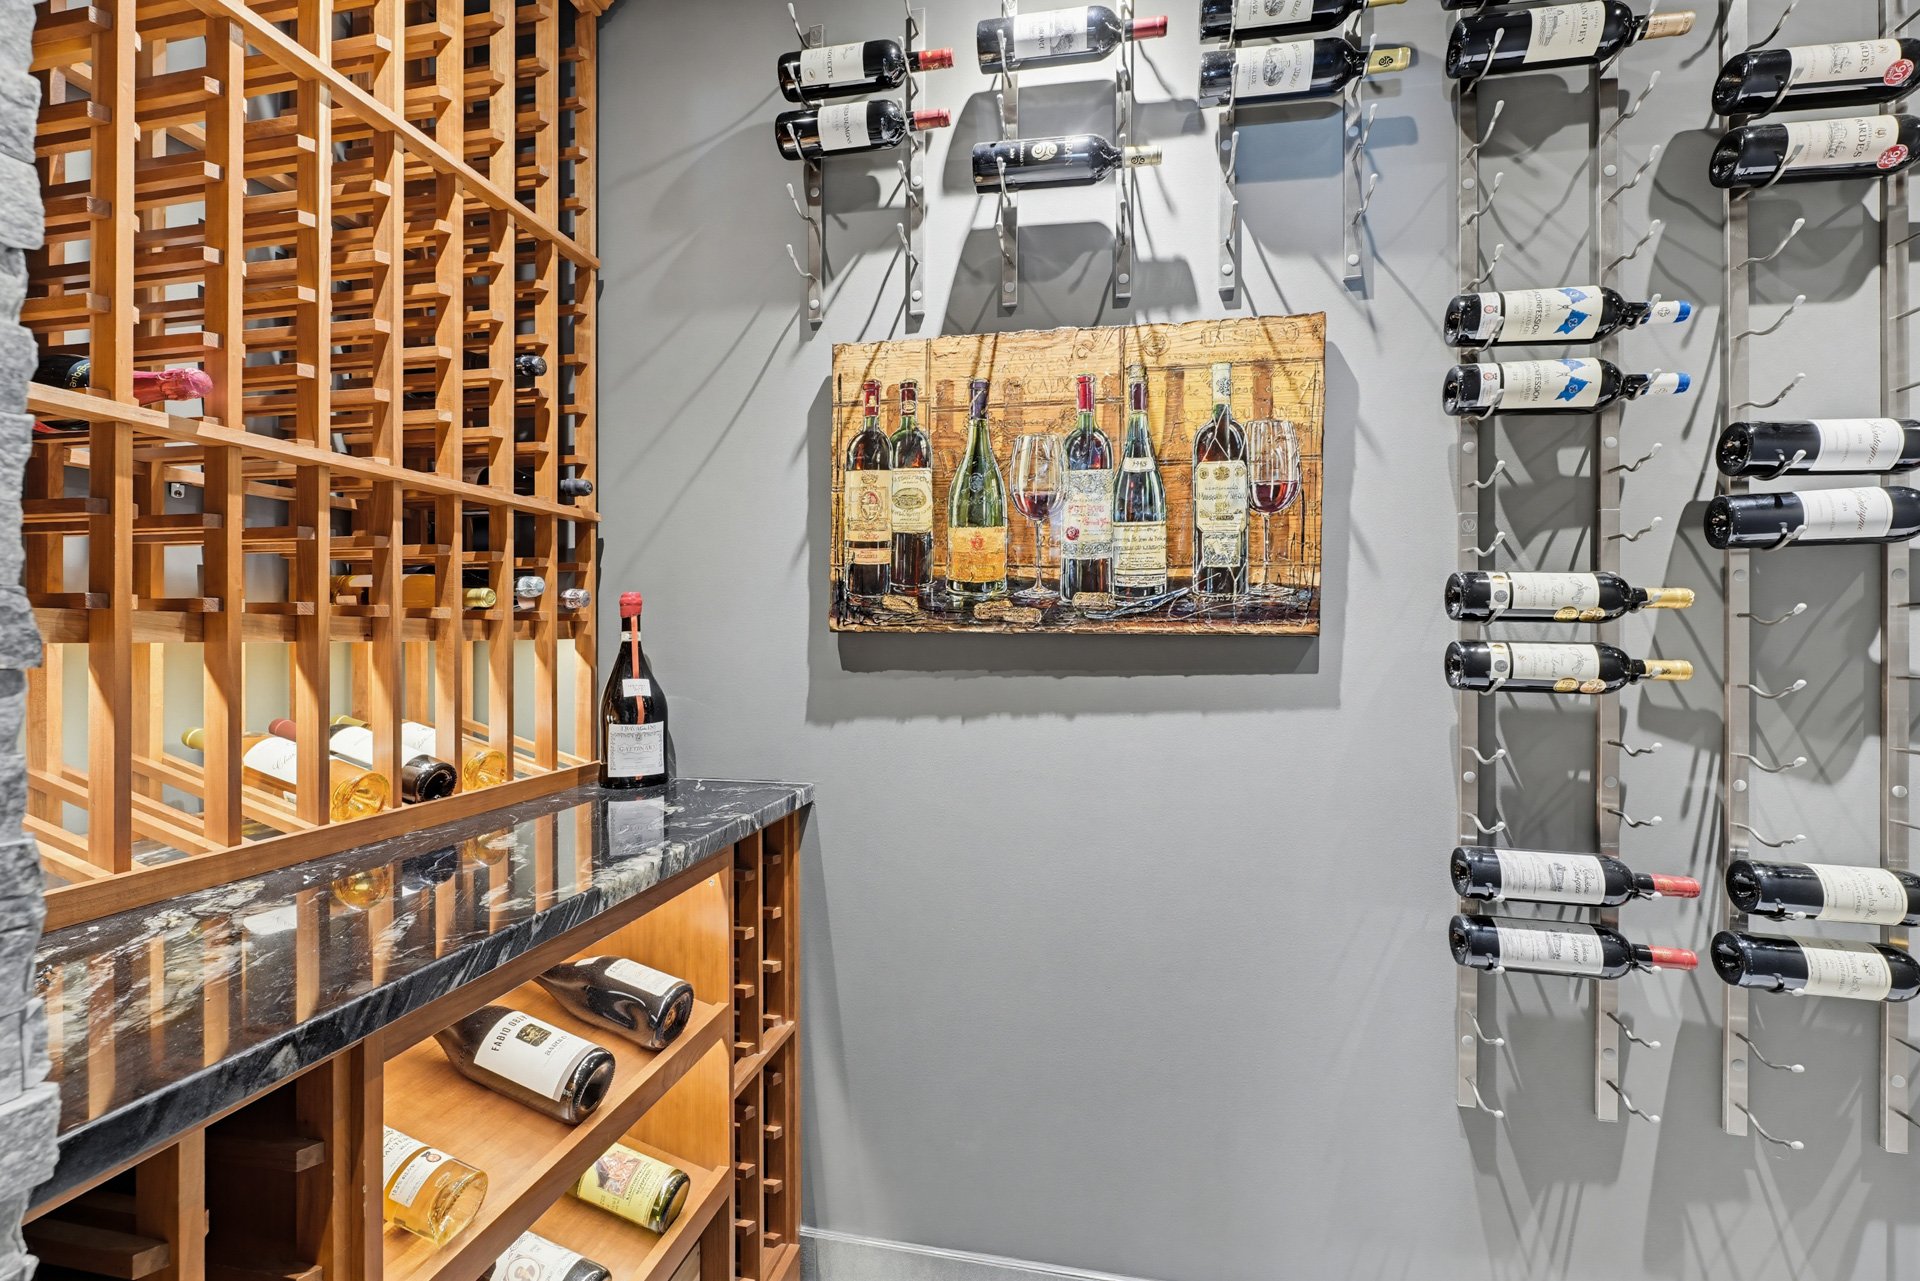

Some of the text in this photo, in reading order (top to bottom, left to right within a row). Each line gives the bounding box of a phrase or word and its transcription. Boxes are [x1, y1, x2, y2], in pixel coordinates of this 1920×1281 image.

[1890, 64, 1906, 80] 90
[1886, 150, 1901, 164] 90
[490, 1027, 511, 1052] FABIO
